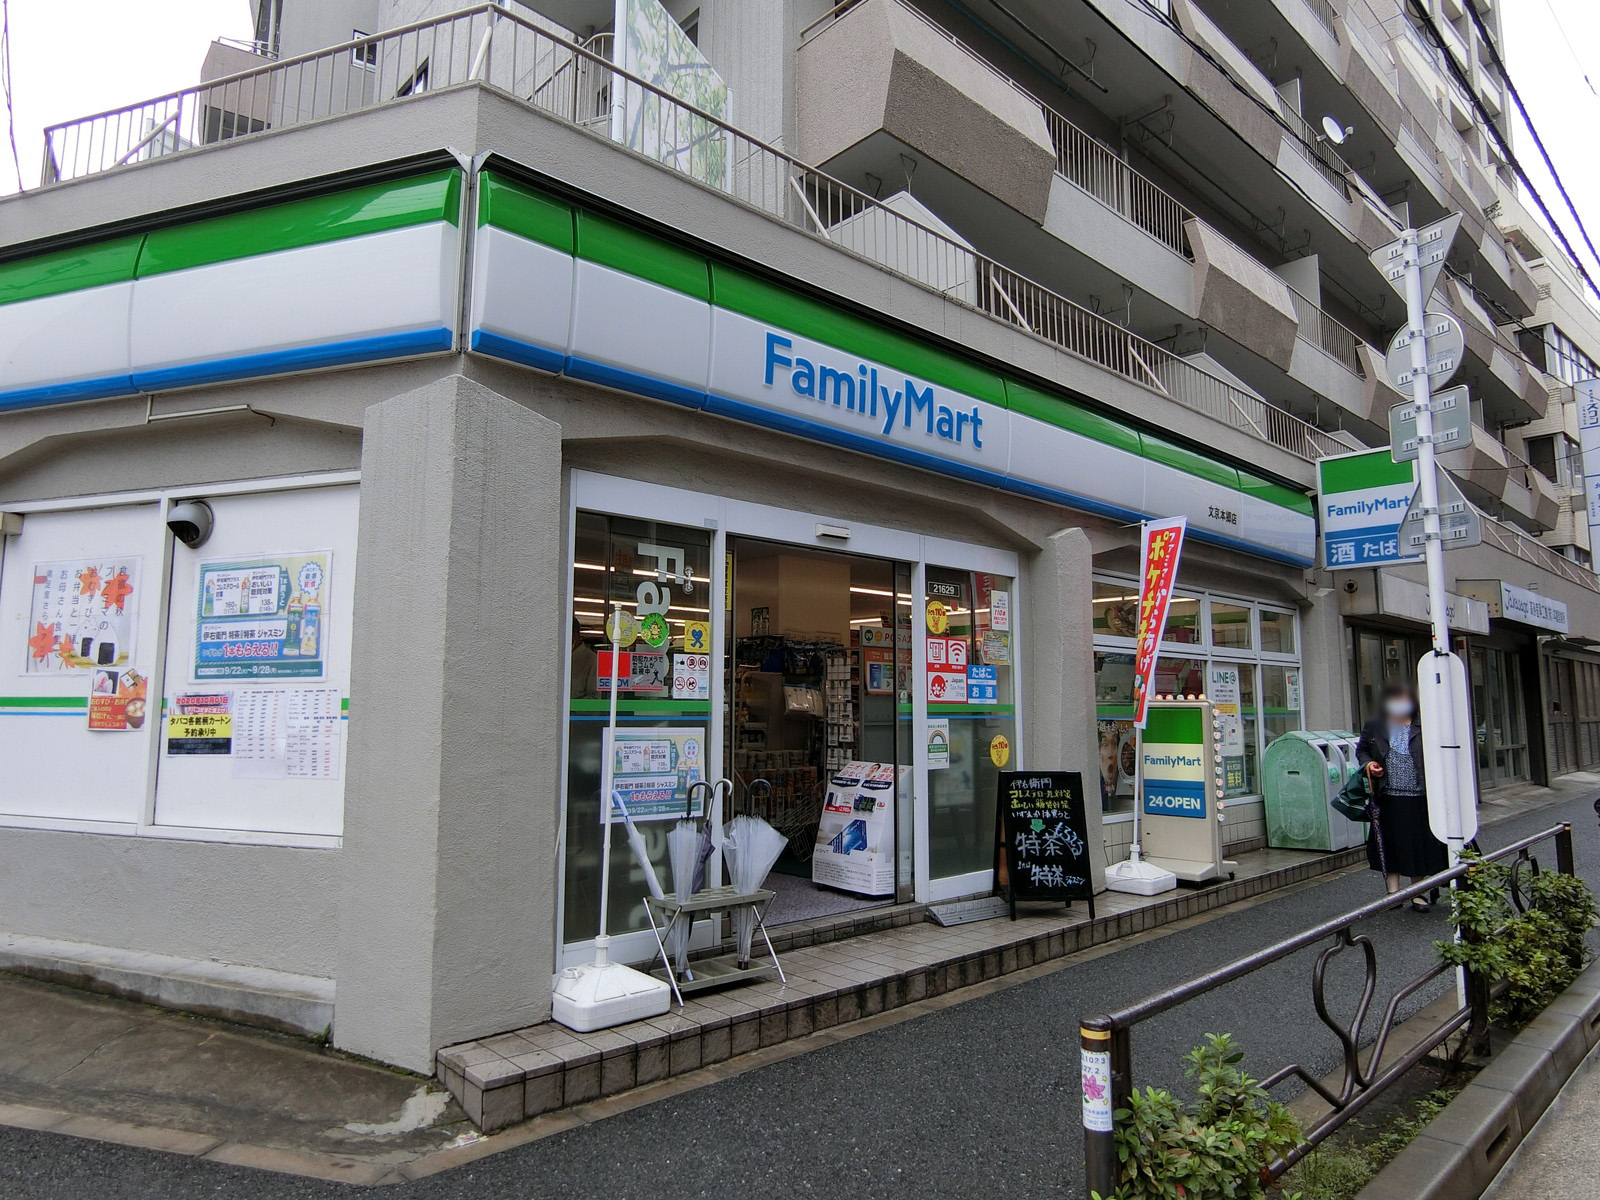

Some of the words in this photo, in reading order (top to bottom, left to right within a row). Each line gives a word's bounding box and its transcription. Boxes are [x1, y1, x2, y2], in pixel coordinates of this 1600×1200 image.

[763, 330, 984, 448] FamilyMart
[1327, 495, 1410, 518] FamilyMart
[1330, 542, 1356, 563] 酒
[1362, 539, 1398, 558] たば
[933, 584, 955, 595] 21629
[203, 631, 228, 641] 伊右衛門
[257, 628, 285, 638] ジャスミン
[971, 667, 993, 678] たばこ
[599, 678, 629, 687] SEOM
[170, 716, 232, 726] タバコ各銘柄カートン
[184, 728, 216, 737] 予約承り中
[1144, 754, 1202, 768] FamilyMart
[1009, 777, 1052, 790] 伊右衛門
[1009, 789, 1073, 800] コレステロール対策
[1015, 831, 1064, 859] 特茶
[1031, 864, 1067, 888] 特茶
